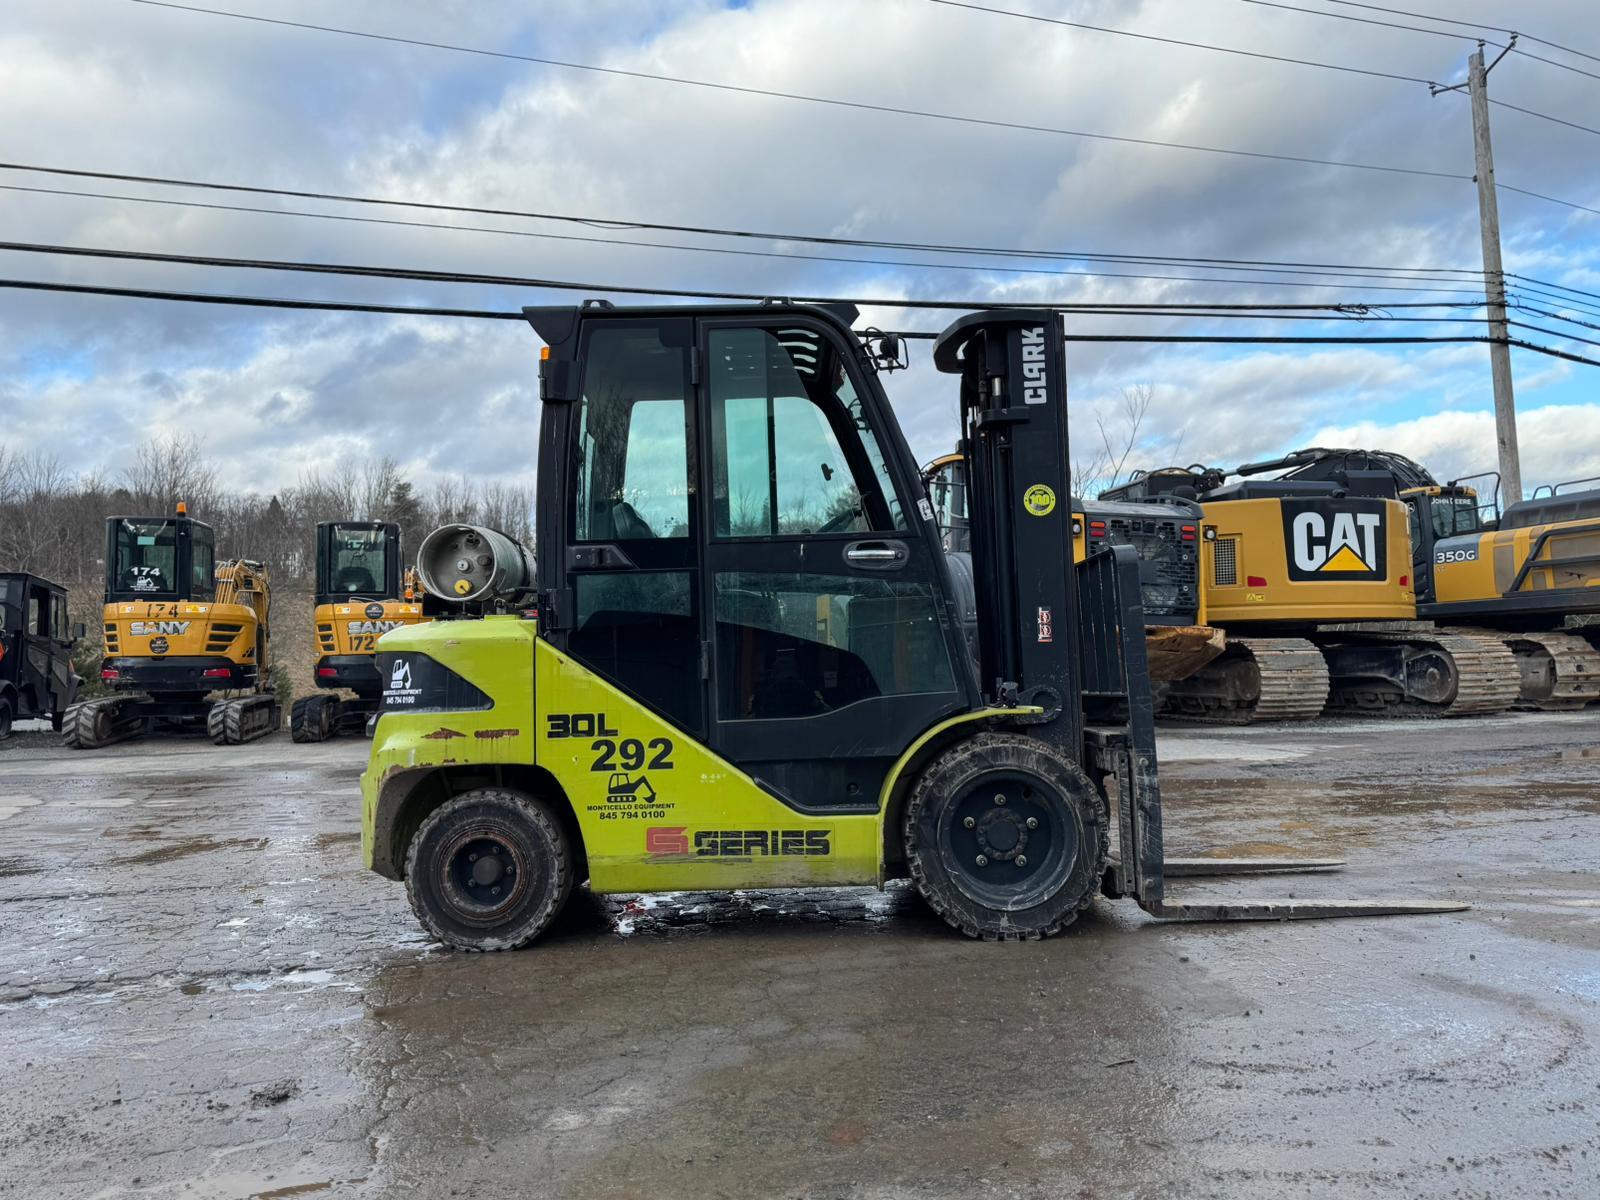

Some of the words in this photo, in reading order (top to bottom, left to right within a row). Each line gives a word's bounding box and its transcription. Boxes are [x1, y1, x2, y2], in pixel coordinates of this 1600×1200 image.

[1021, 327, 1047, 405] CLARK
[1431, 497, 1450, 505] JOHN
[1293, 511, 1380, 572] CAT
[1436, 550, 1475, 564] 350G
[131, 566, 161, 576] 174
[147, 603, 178, 618] 174
[130, 621, 192, 636] SANY
[348, 620, 405, 635] SANY
[349, 635, 375, 651] 172
[547, 713, 619, 739] 30L
[590, 737, 674, 771] 292
[599, 811, 618, 820] 845
[621, 810, 639, 819] 794
[641, 810, 666, 819] 0100
[694, 830, 832, 856] SERIES
